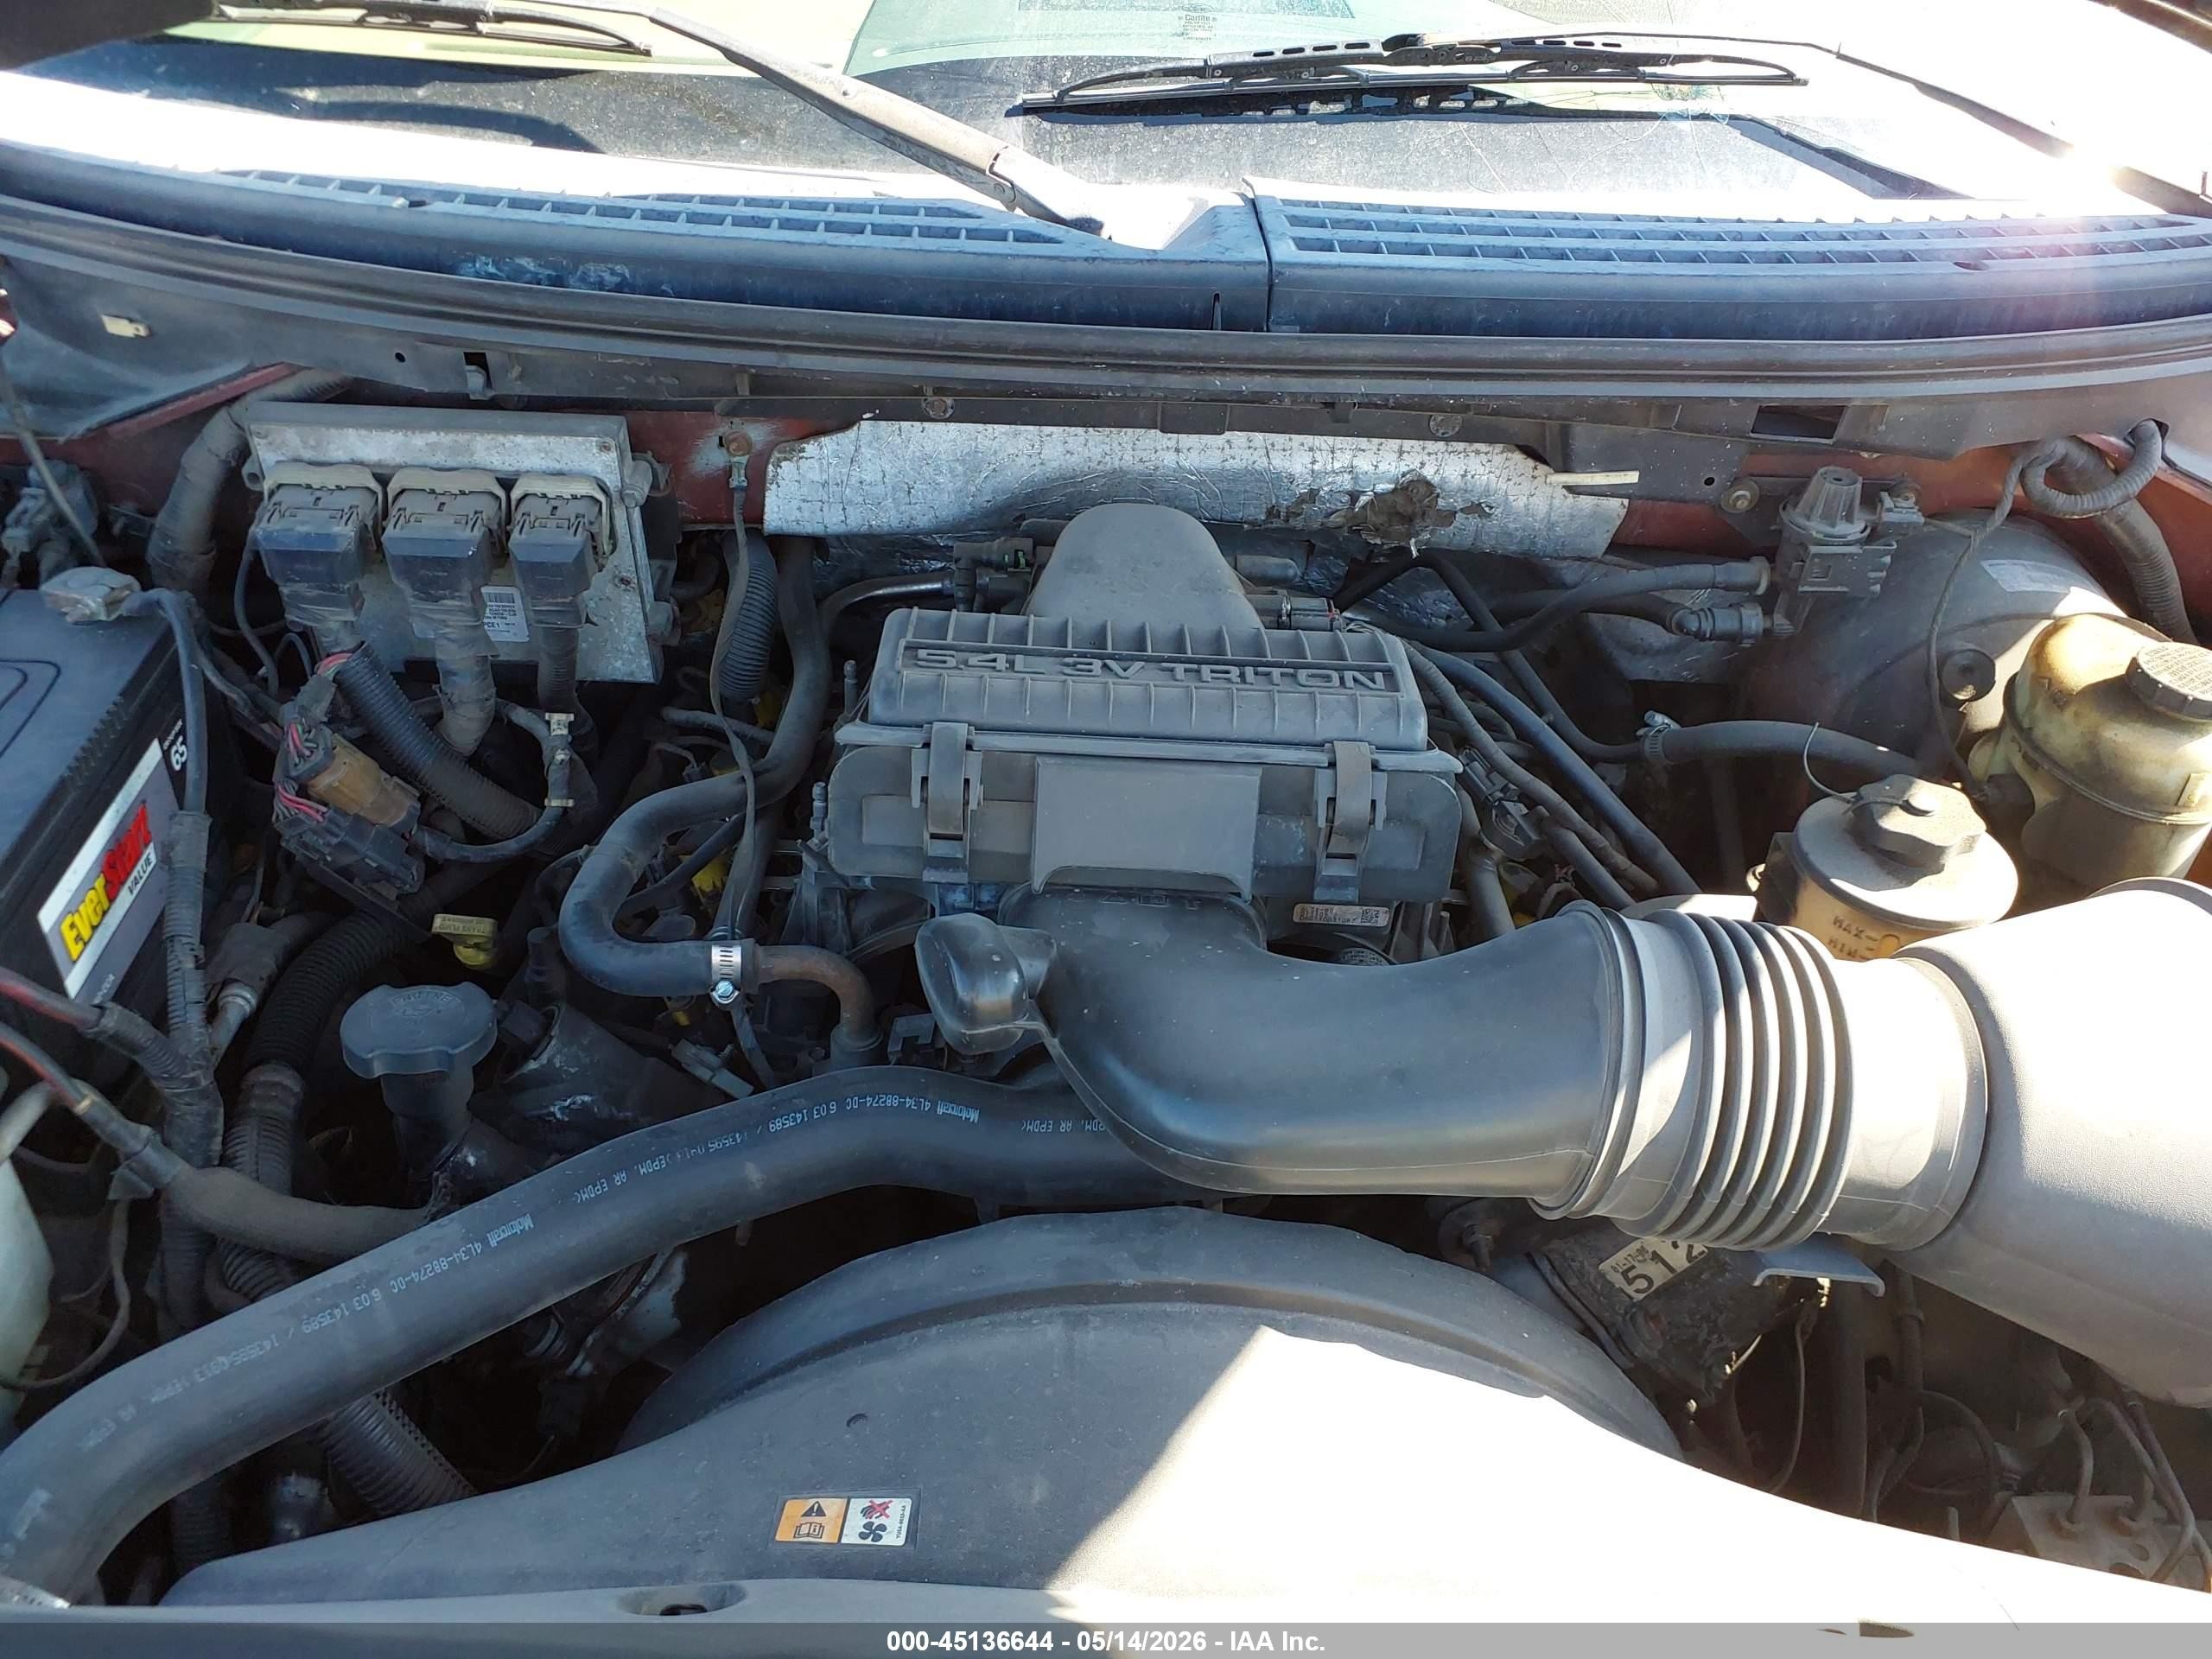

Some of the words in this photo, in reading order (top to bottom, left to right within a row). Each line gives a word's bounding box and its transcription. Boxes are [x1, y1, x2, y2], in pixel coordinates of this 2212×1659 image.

[917, 649, 1046, 677] 5.4L
[1061, 656, 1145, 680] 3V
[1161, 662, 1386, 690] TRITON
[171, 735, 188, 771] 65
[127, 851, 154, 896] VALUE
[812, 1104, 827, 1120] 03
[829, 1101, 837, 1114] 6
[937, 1100, 980, 1123] Motorcraft
[768, 1109, 809, 1133] 143589
[1059, 1119, 1072, 1133] AR
[613, 1170, 627, 1185] AR
[486, 1213, 535, 1248] Motorcraft
[353, 1293, 371, 1311] 03
[372, 1287, 382, 1301] 6
[302, 1302, 350, 1333] 143589
